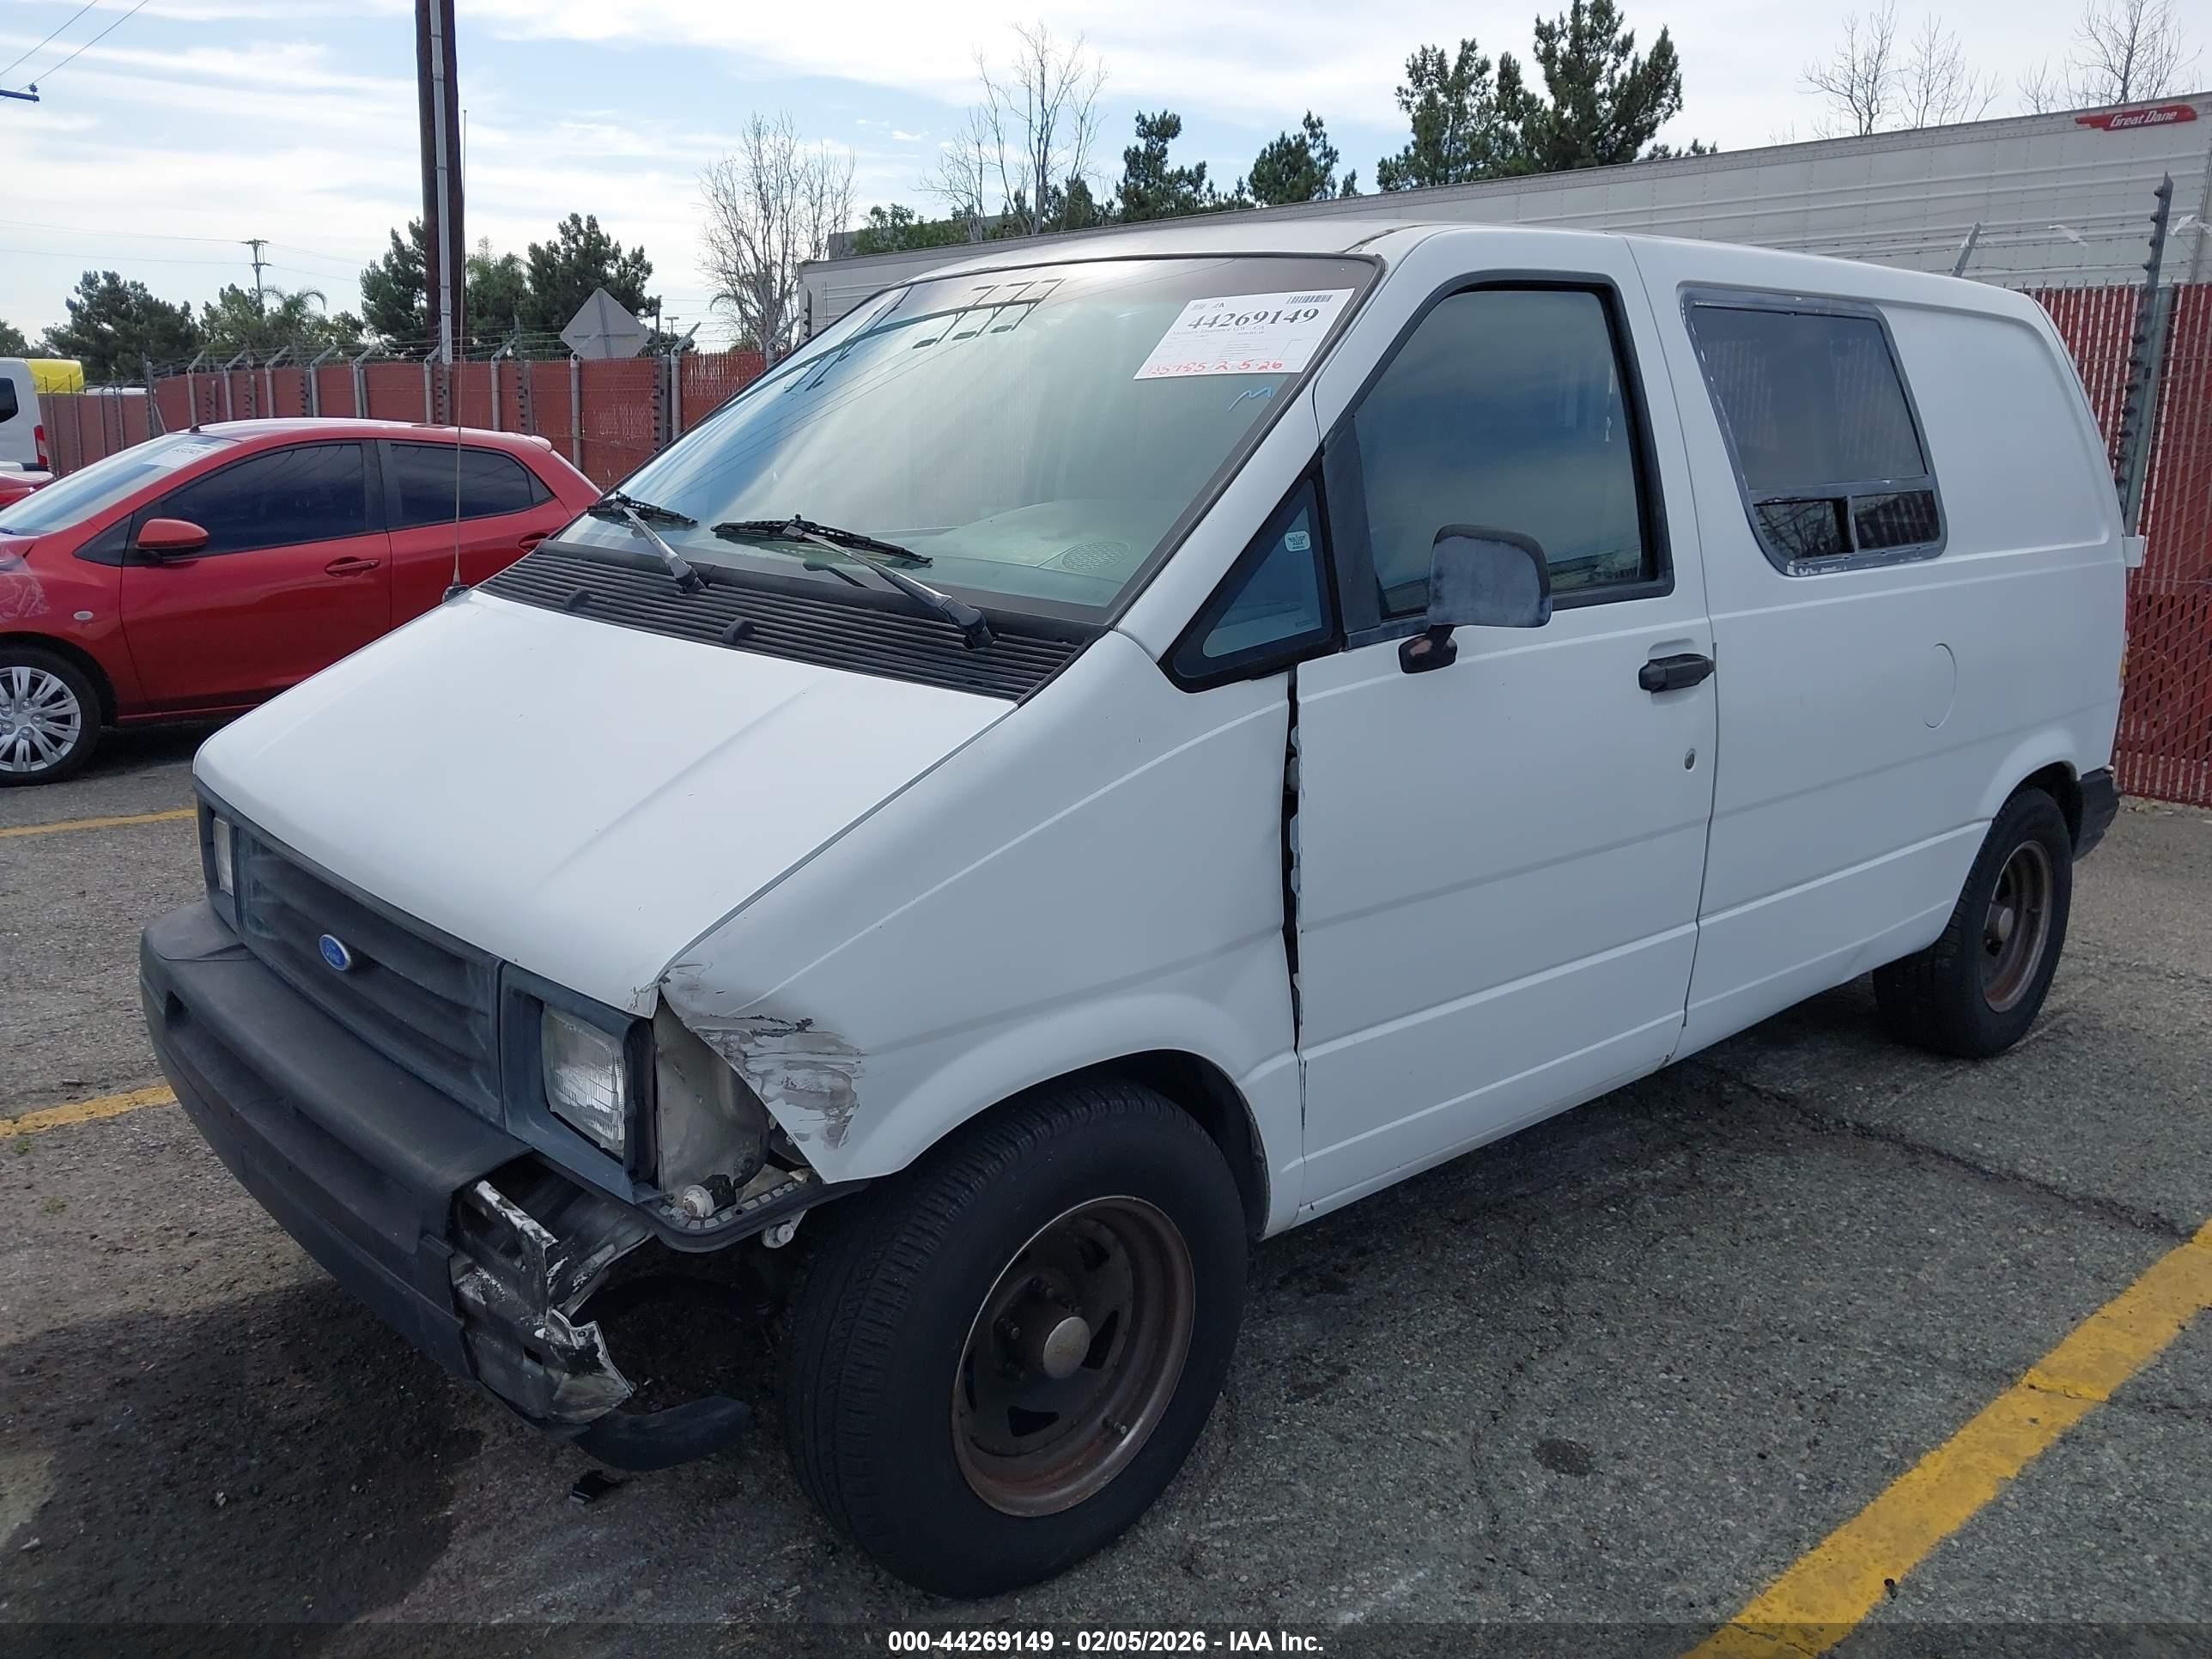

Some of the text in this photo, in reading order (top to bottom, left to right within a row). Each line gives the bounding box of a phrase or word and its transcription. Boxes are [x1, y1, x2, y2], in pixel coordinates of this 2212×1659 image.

[2110, 109, 2178, 127] Great Dane
[1188, 308, 1320, 330] 44269149
